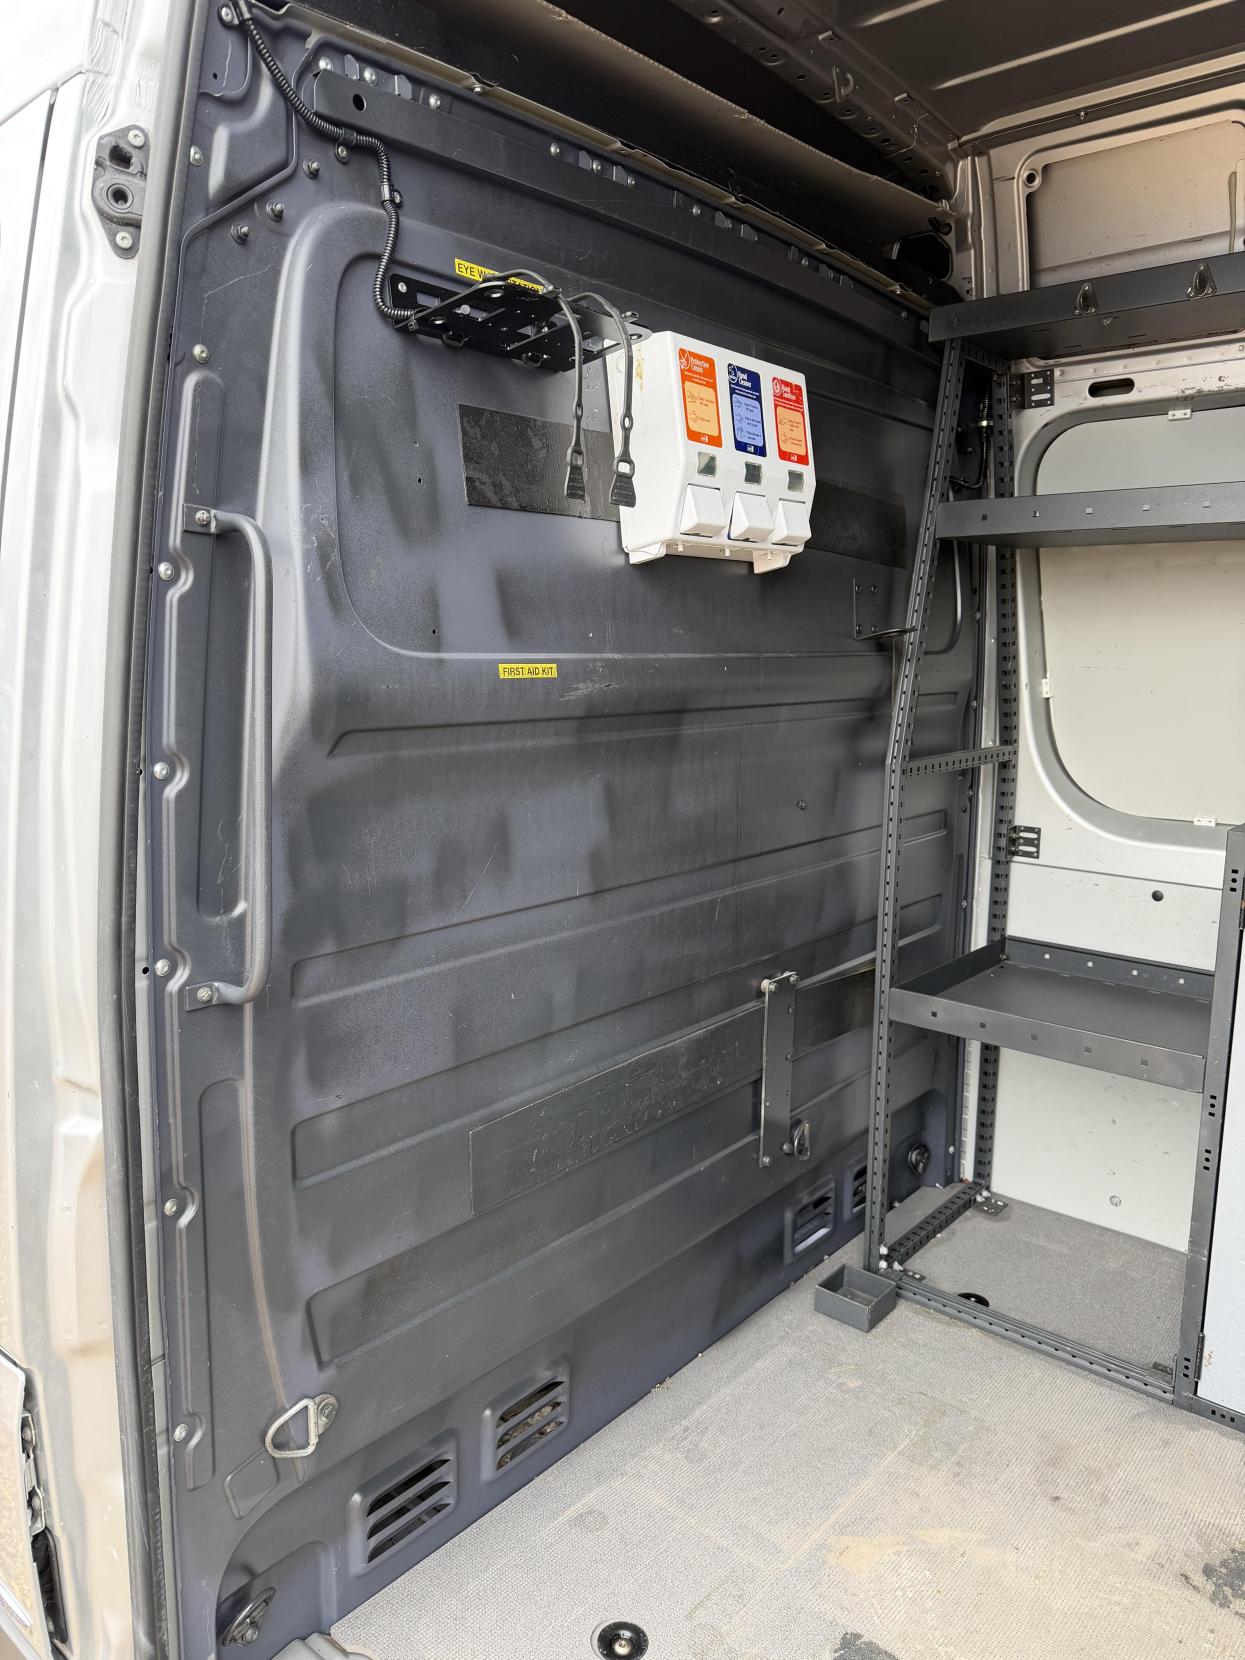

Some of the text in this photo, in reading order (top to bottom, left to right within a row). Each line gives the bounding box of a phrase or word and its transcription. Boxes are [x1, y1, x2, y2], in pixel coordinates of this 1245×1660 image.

[457, 263, 475, 277] EYE
[502, 666, 554, 676] FIRST AID KIT
